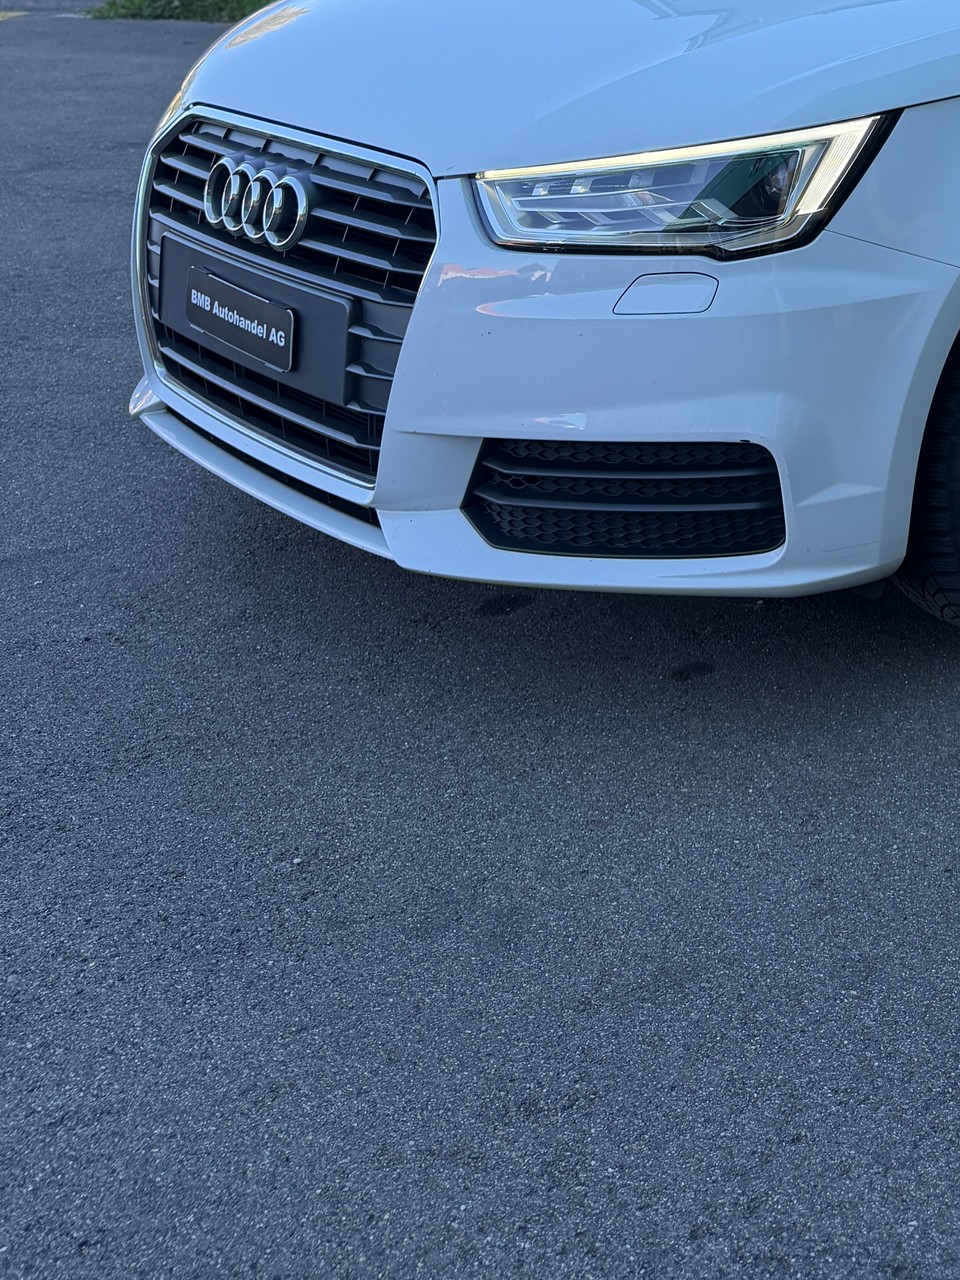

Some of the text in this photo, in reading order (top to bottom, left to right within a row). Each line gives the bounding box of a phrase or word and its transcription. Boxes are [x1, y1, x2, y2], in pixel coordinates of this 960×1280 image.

[191, 289, 285, 347] BMB Autohandel AG
